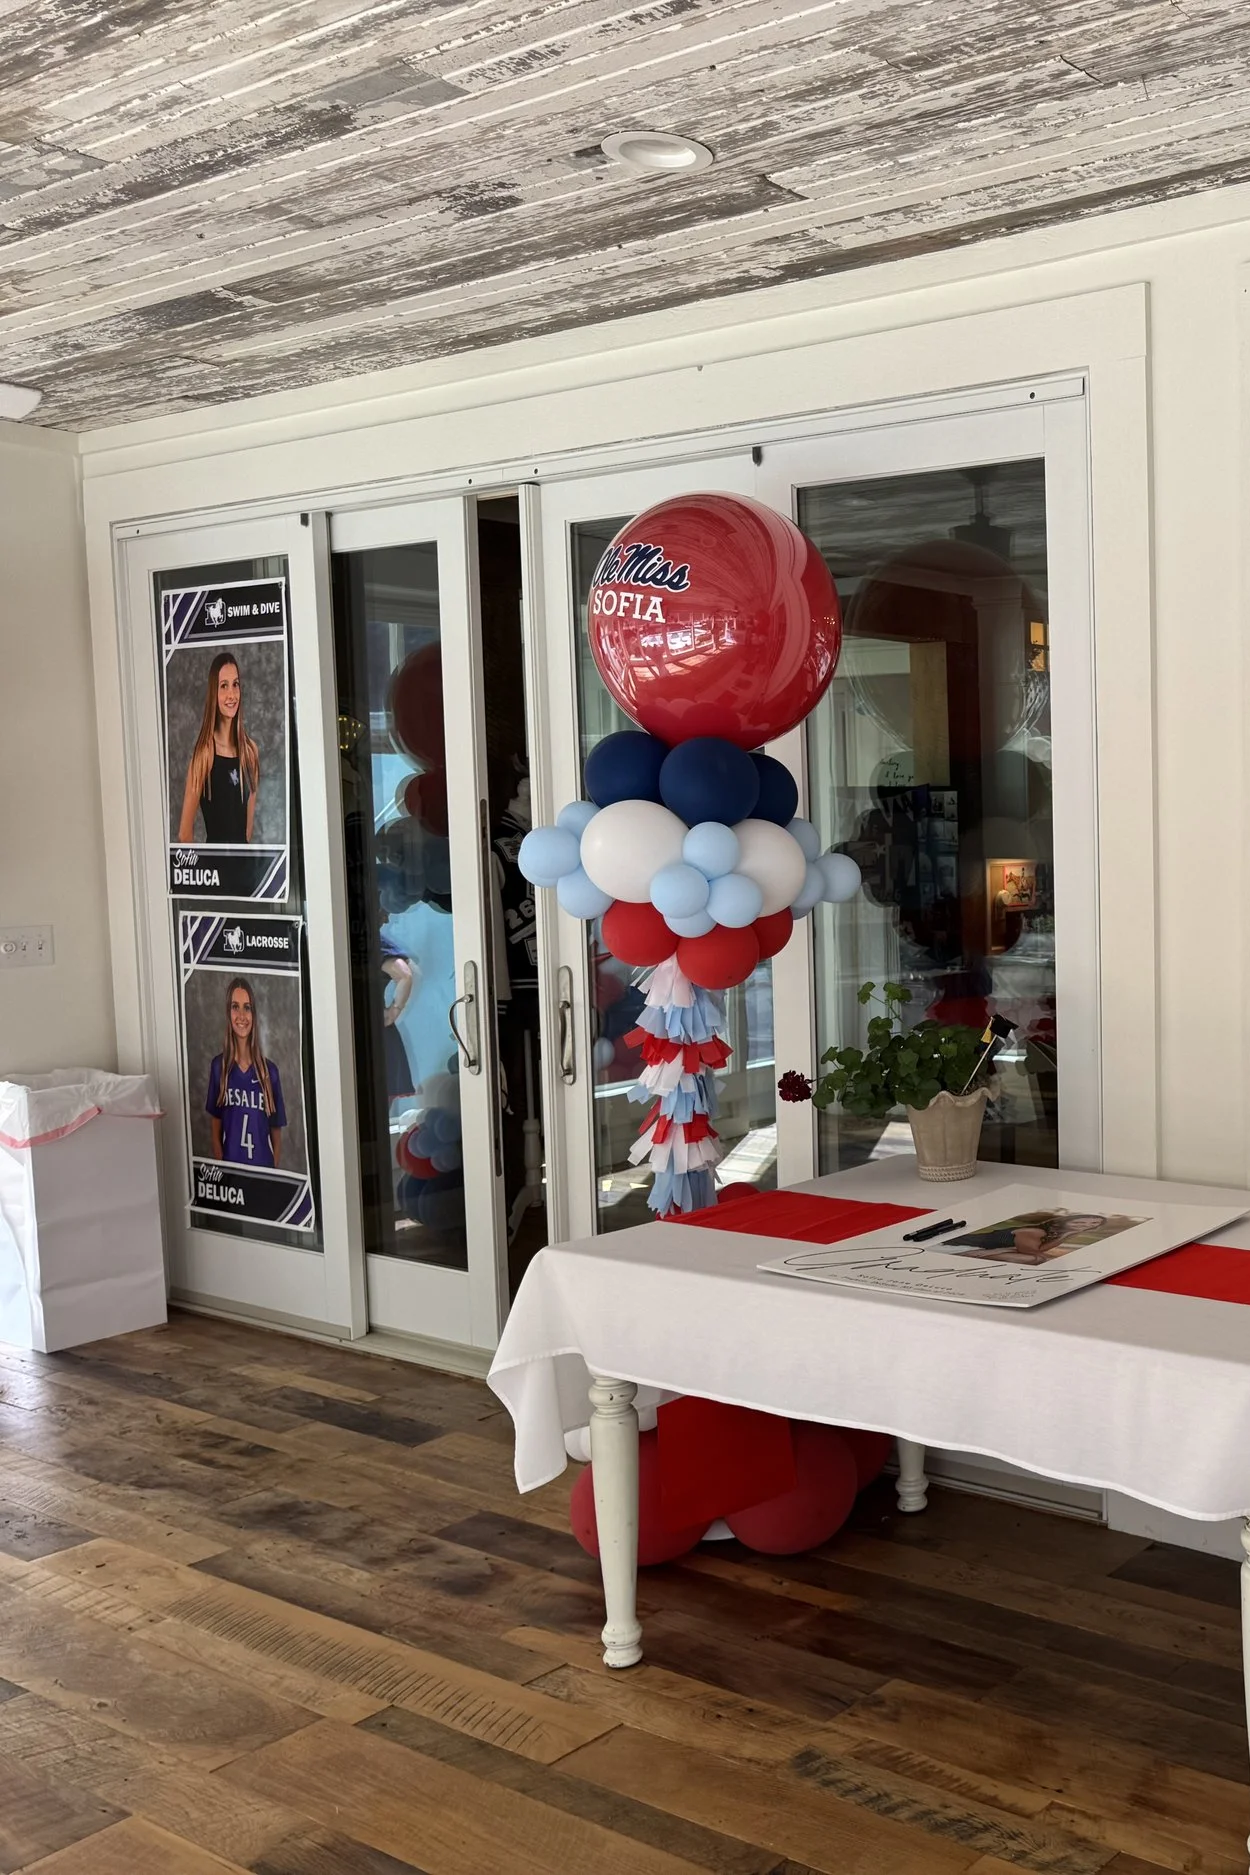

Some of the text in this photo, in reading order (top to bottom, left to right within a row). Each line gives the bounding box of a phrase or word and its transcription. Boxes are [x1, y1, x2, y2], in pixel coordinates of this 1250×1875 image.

[592, 542, 691, 593] Ole Miss
[227, 605, 251, 618] SWIM
[252, 603, 260, 616] &
[260, 601, 280, 615] DIVE
[593, 589, 666, 623] SOFIA
[174, 868, 221, 887] DELUCA
[504, 899, 536, 930] 26
[246, 935, 289, 949] LACROSSE
[240, 1114, 255, 1160] 4
[198, 1181, 246, 1206] DELUCA
